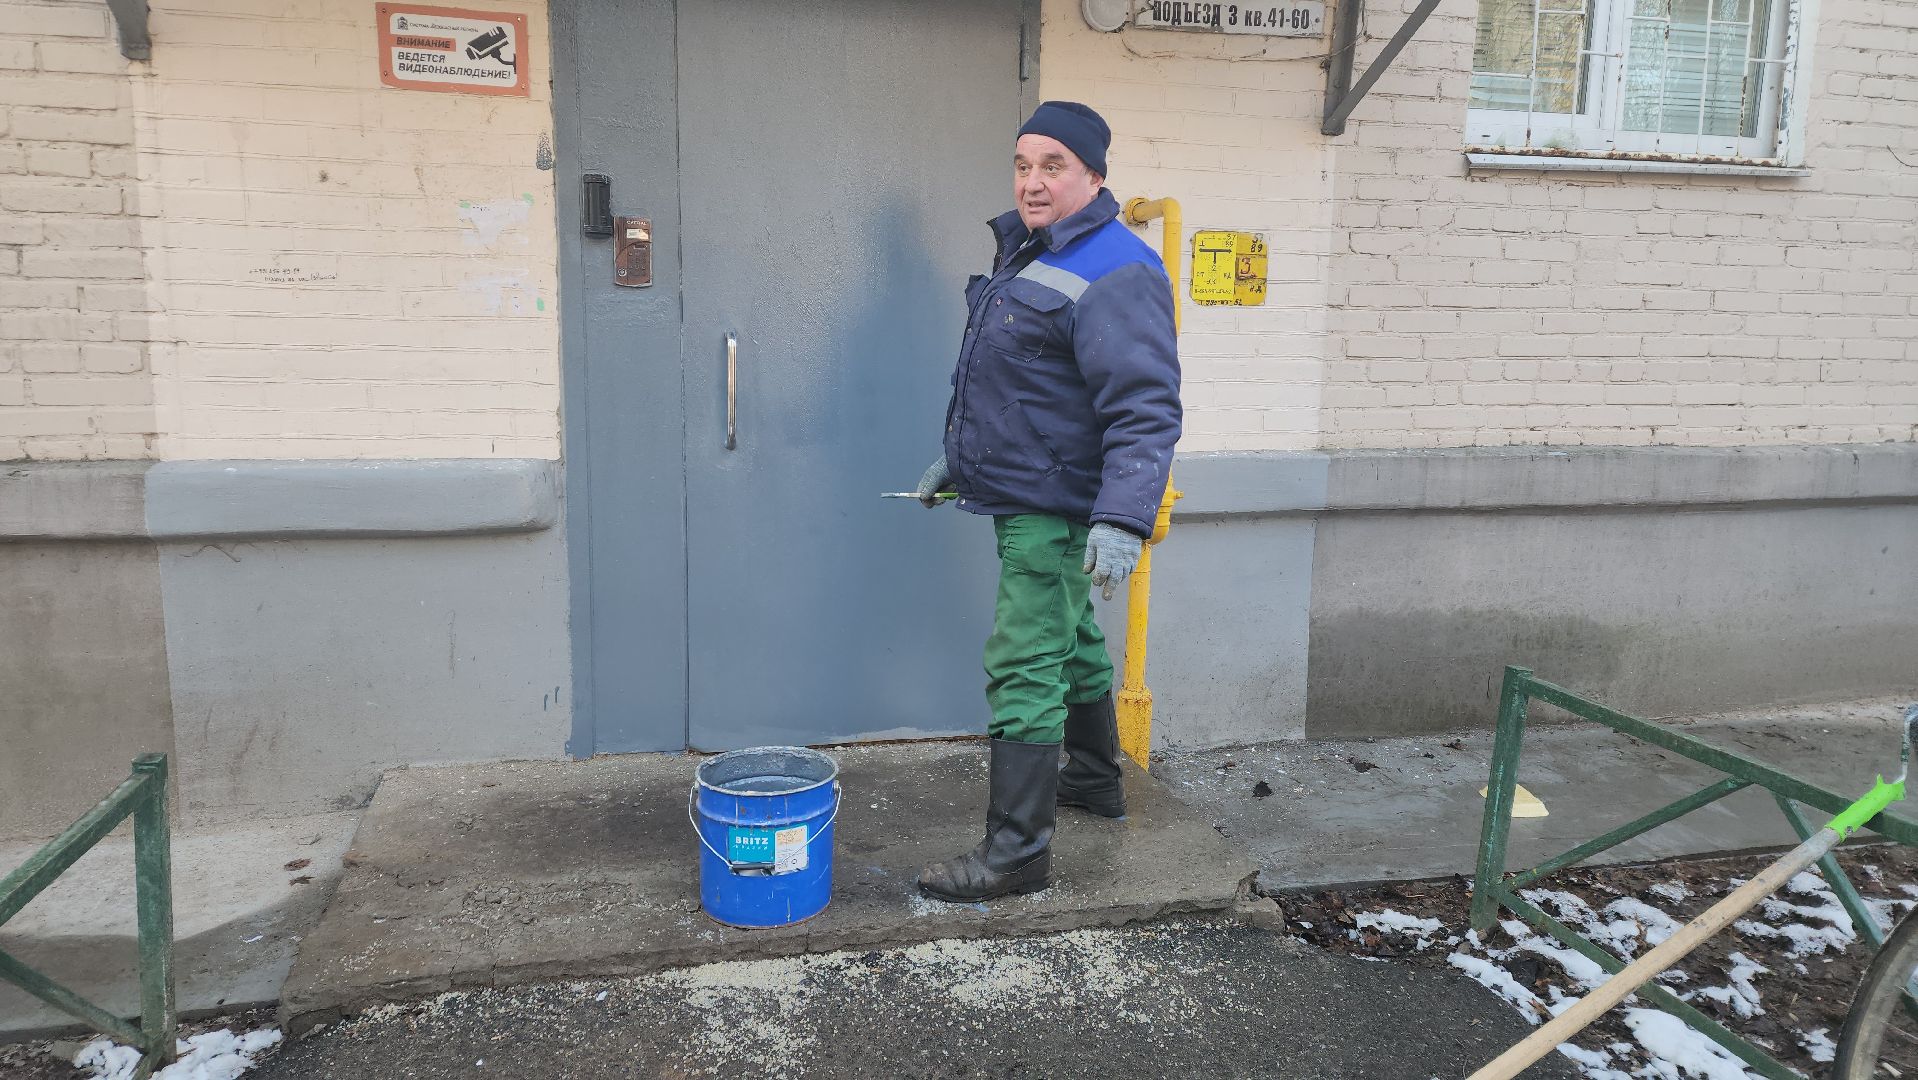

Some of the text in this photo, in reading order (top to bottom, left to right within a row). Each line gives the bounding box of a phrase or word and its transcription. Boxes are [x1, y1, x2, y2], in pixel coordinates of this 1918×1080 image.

[1153, 0, 1221, 27] ПОДЪЕЗД
[1228, 4, 1239, 26] 3
[396, 36, 451, 49] ВНИМАНИЕ
[397, 51, 446, 64] ВЕДЕТСЯ
[399, 63, 511, 79] ВИДЕОНАБЛЮДЕНИЕ!
[1250, 243, 1263, 252] 89
[735, 836, 769, 845] BRITZ
